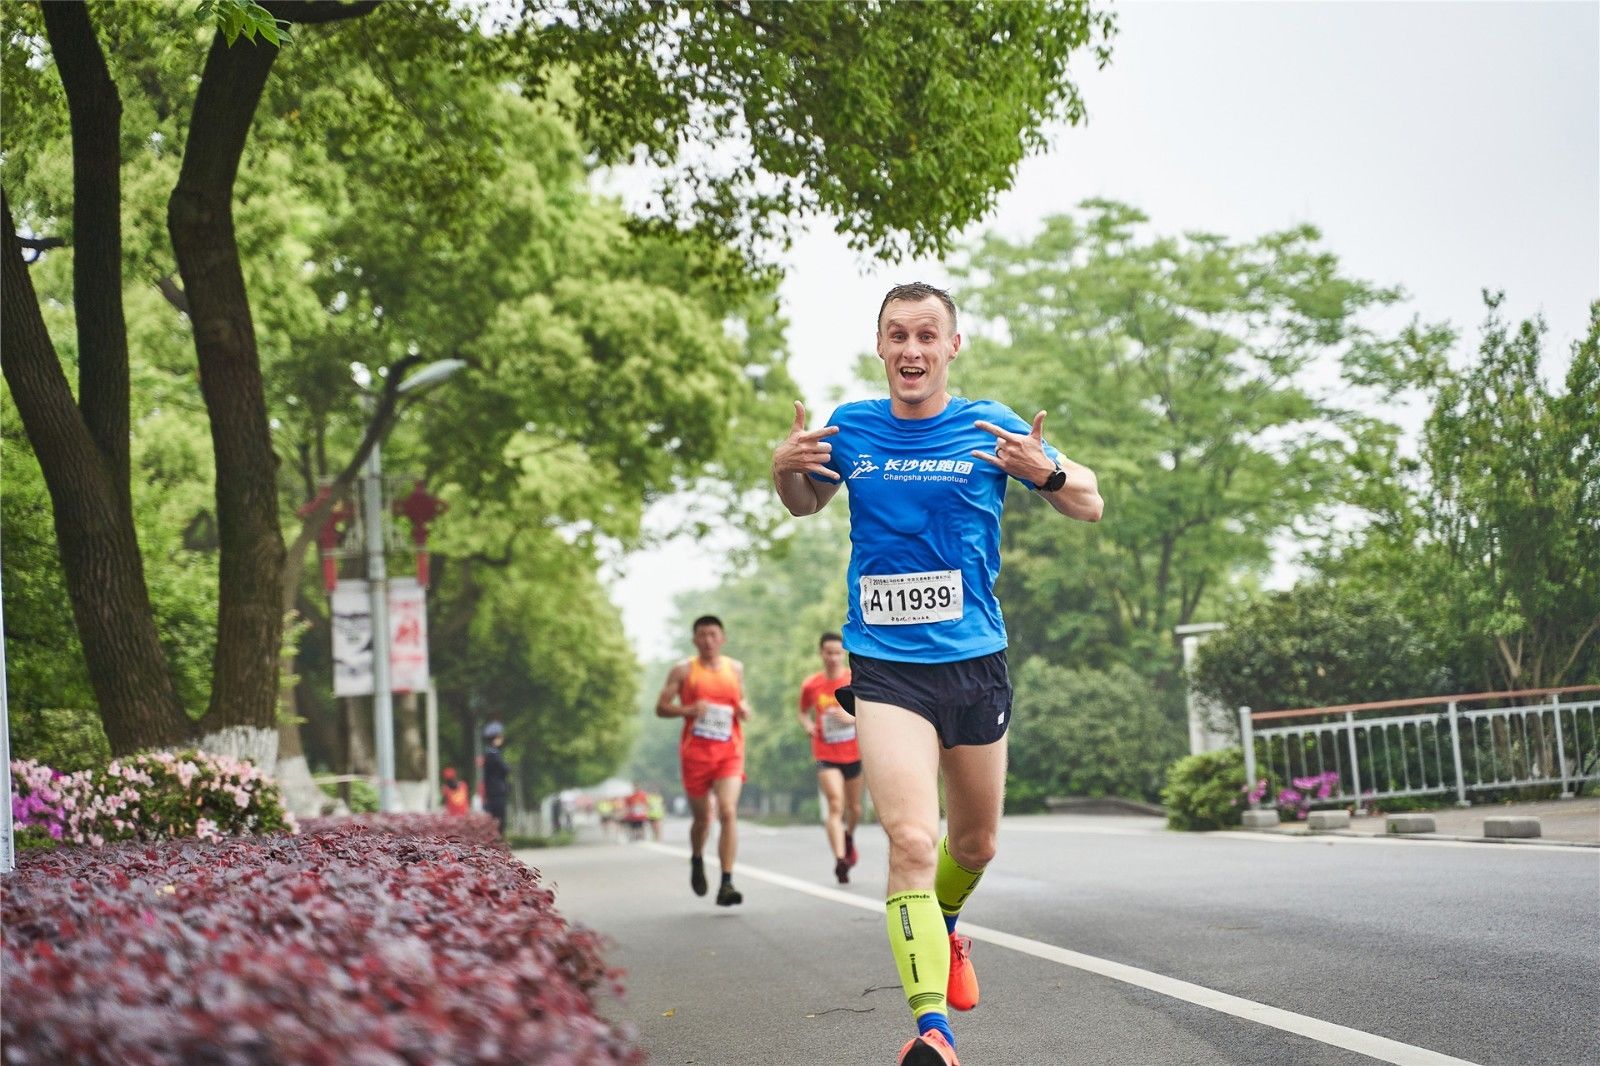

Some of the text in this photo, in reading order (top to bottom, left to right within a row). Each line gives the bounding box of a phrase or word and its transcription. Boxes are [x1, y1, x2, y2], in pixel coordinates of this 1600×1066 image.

[884, 458, 974, 474] 长沙悦跑团
[923, 475, 968, 484] yuepaotuan
[870, 585, 951, 611] A11939
